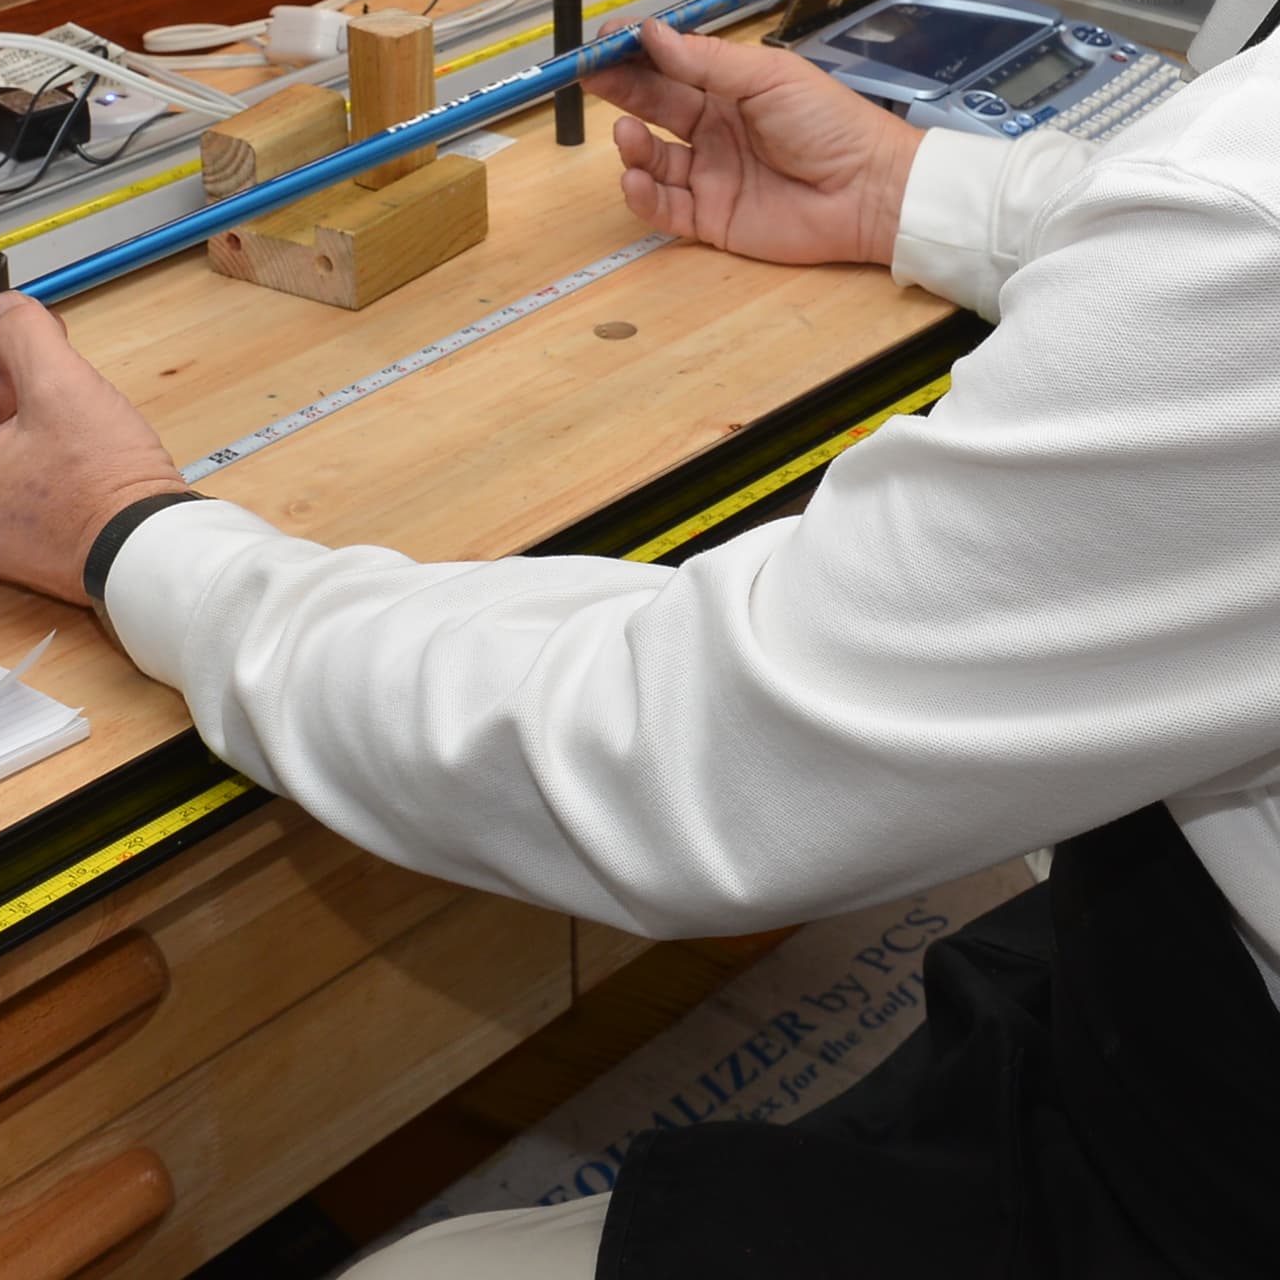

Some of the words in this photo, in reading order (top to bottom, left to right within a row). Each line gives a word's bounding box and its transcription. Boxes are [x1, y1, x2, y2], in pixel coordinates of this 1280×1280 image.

[123, 835, 145, 850] 20
[178, 805, 197, 819] 21
[537, 1008, 819, 1207] EQALIZER
[800, 971, 873, 1015] by
[854, 906, 952, 975] PCS
[778, 1060, 821, 1104] for
[819, 1026, 862, 1067] the
[858, 980, 920, 1031] Golf
